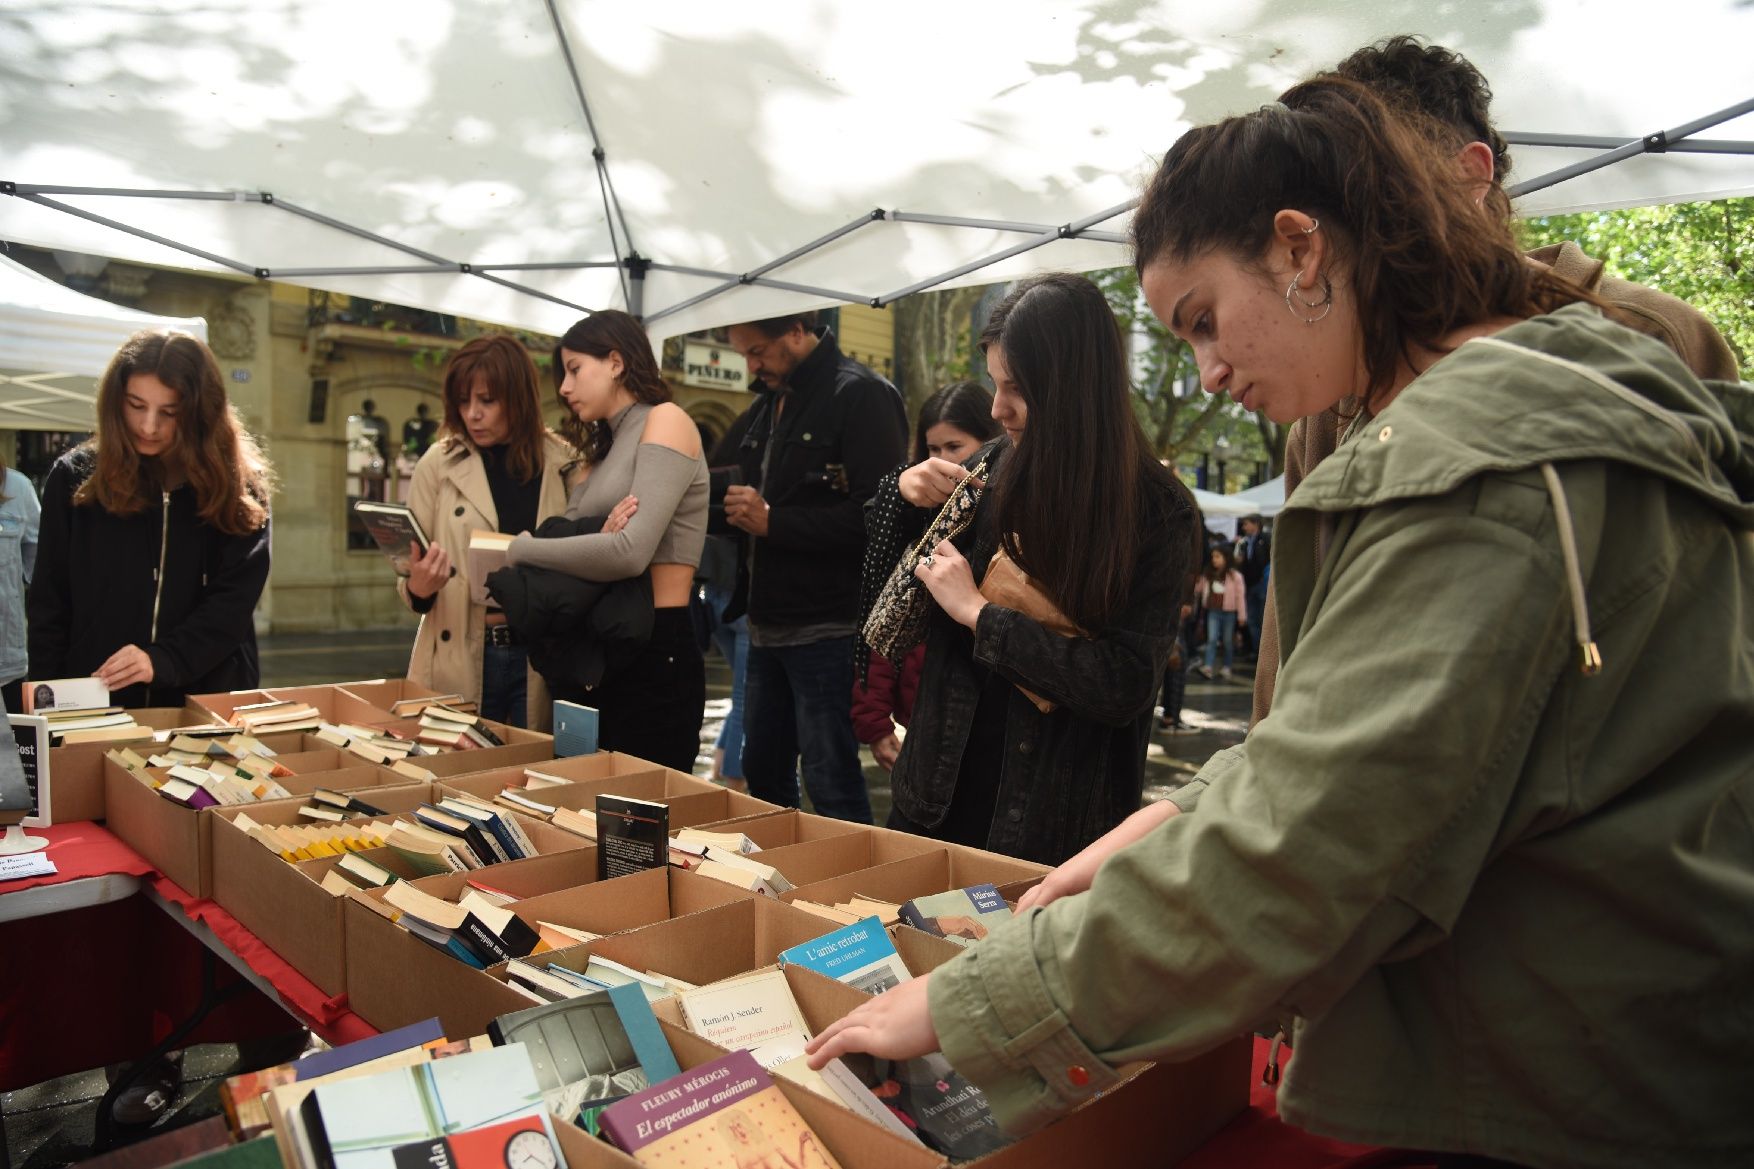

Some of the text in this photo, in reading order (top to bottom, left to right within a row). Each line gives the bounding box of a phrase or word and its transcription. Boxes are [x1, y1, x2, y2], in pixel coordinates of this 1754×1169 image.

[978, 900, 998, 909] Serra
[493, 945, 503, 955] una
[806, 929, 869, 961] L'amic retrobat
[826, 947, 867, 968] FRED UHLMAN
[701, 1012, 731, 1027] Ramón
[736, 1006, 764, 1018] Sender
[635, 1119, 653, 1140] El
[653, 1097, 711, 1131] espectador
[711, 1076, 758, 1105] anónimo
[640, 1087, 683, 1112] FLEURY
[922, 1090, 970, 1118] Arundhati
[944, 1111, 960, 1124] El
[958, 1105, 978, 1118] déu
